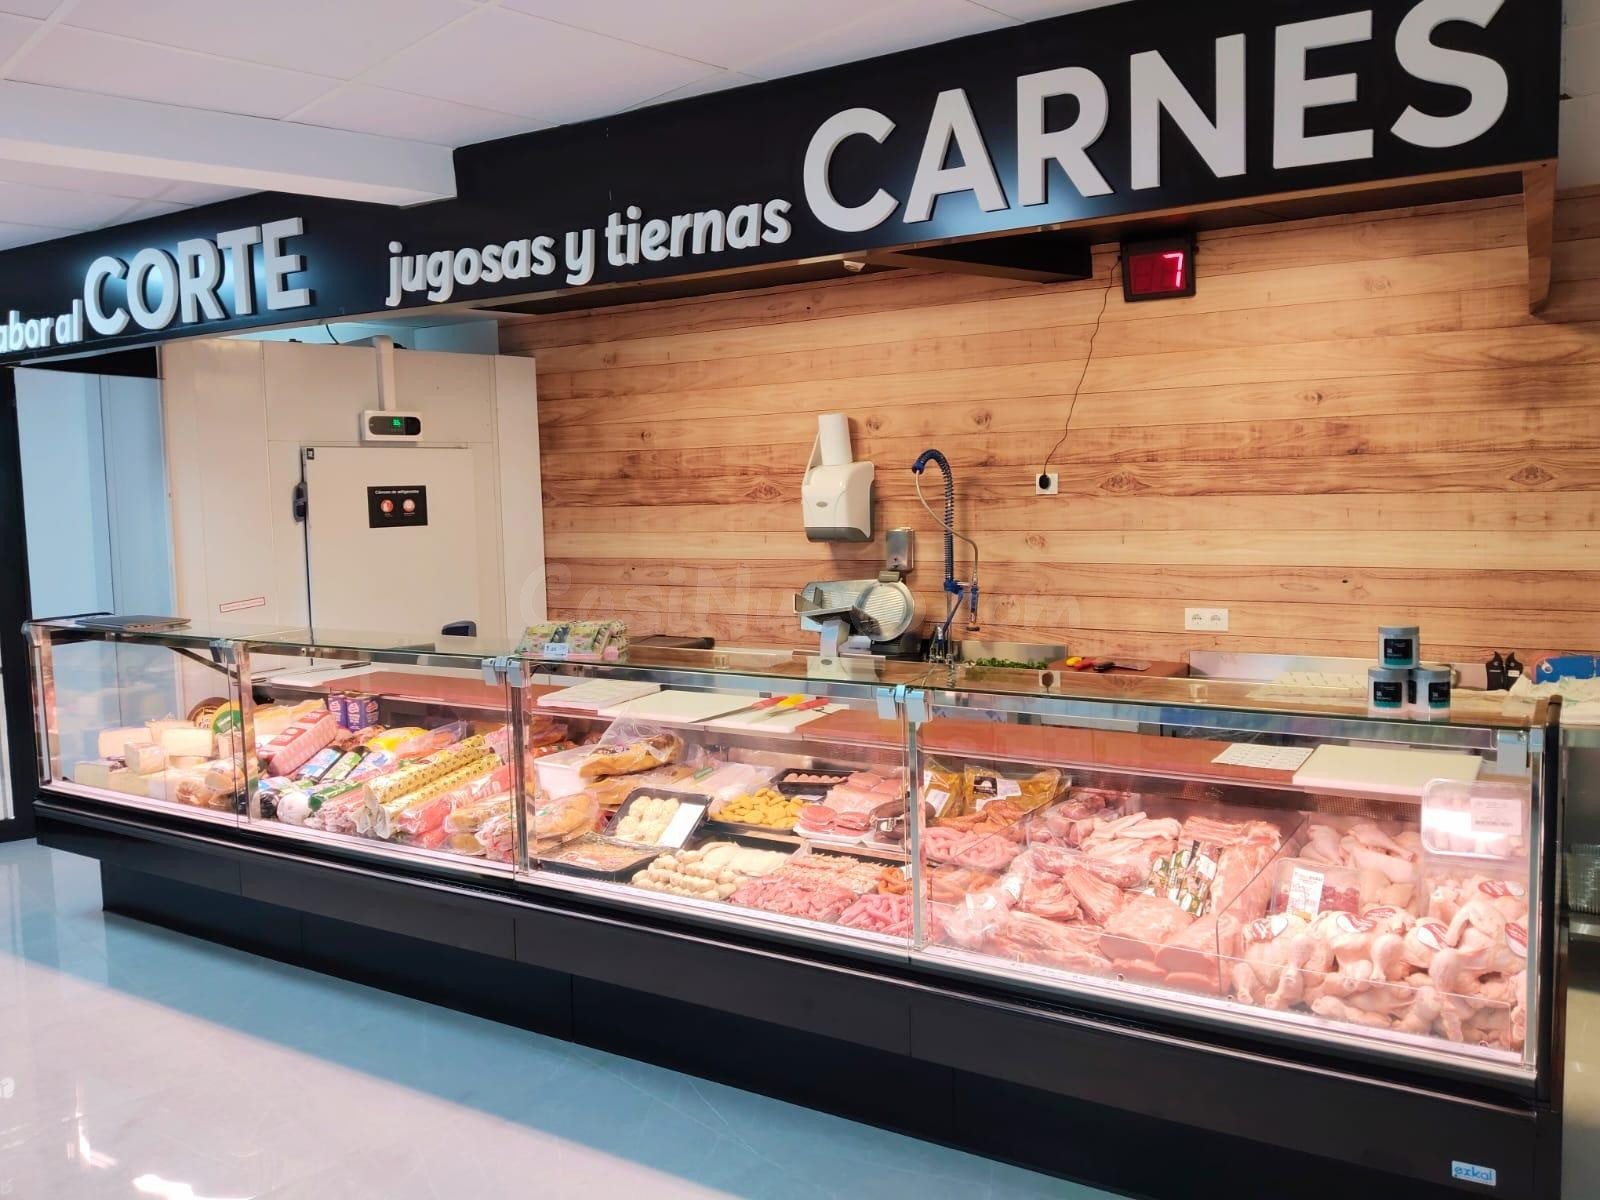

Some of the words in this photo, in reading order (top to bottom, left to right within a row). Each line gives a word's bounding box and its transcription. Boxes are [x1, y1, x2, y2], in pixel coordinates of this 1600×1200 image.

[385, 236, 556, 306] jugosas
[565, 229, 595, 286] y
[605, 199, 792, 267] tiernas
[803, 0, 1510, 233] CARNES
[55, 299, 83, 344] al
[84, 217, 310, 336] CORTE
[1162, 252, 1184, 288] 7
